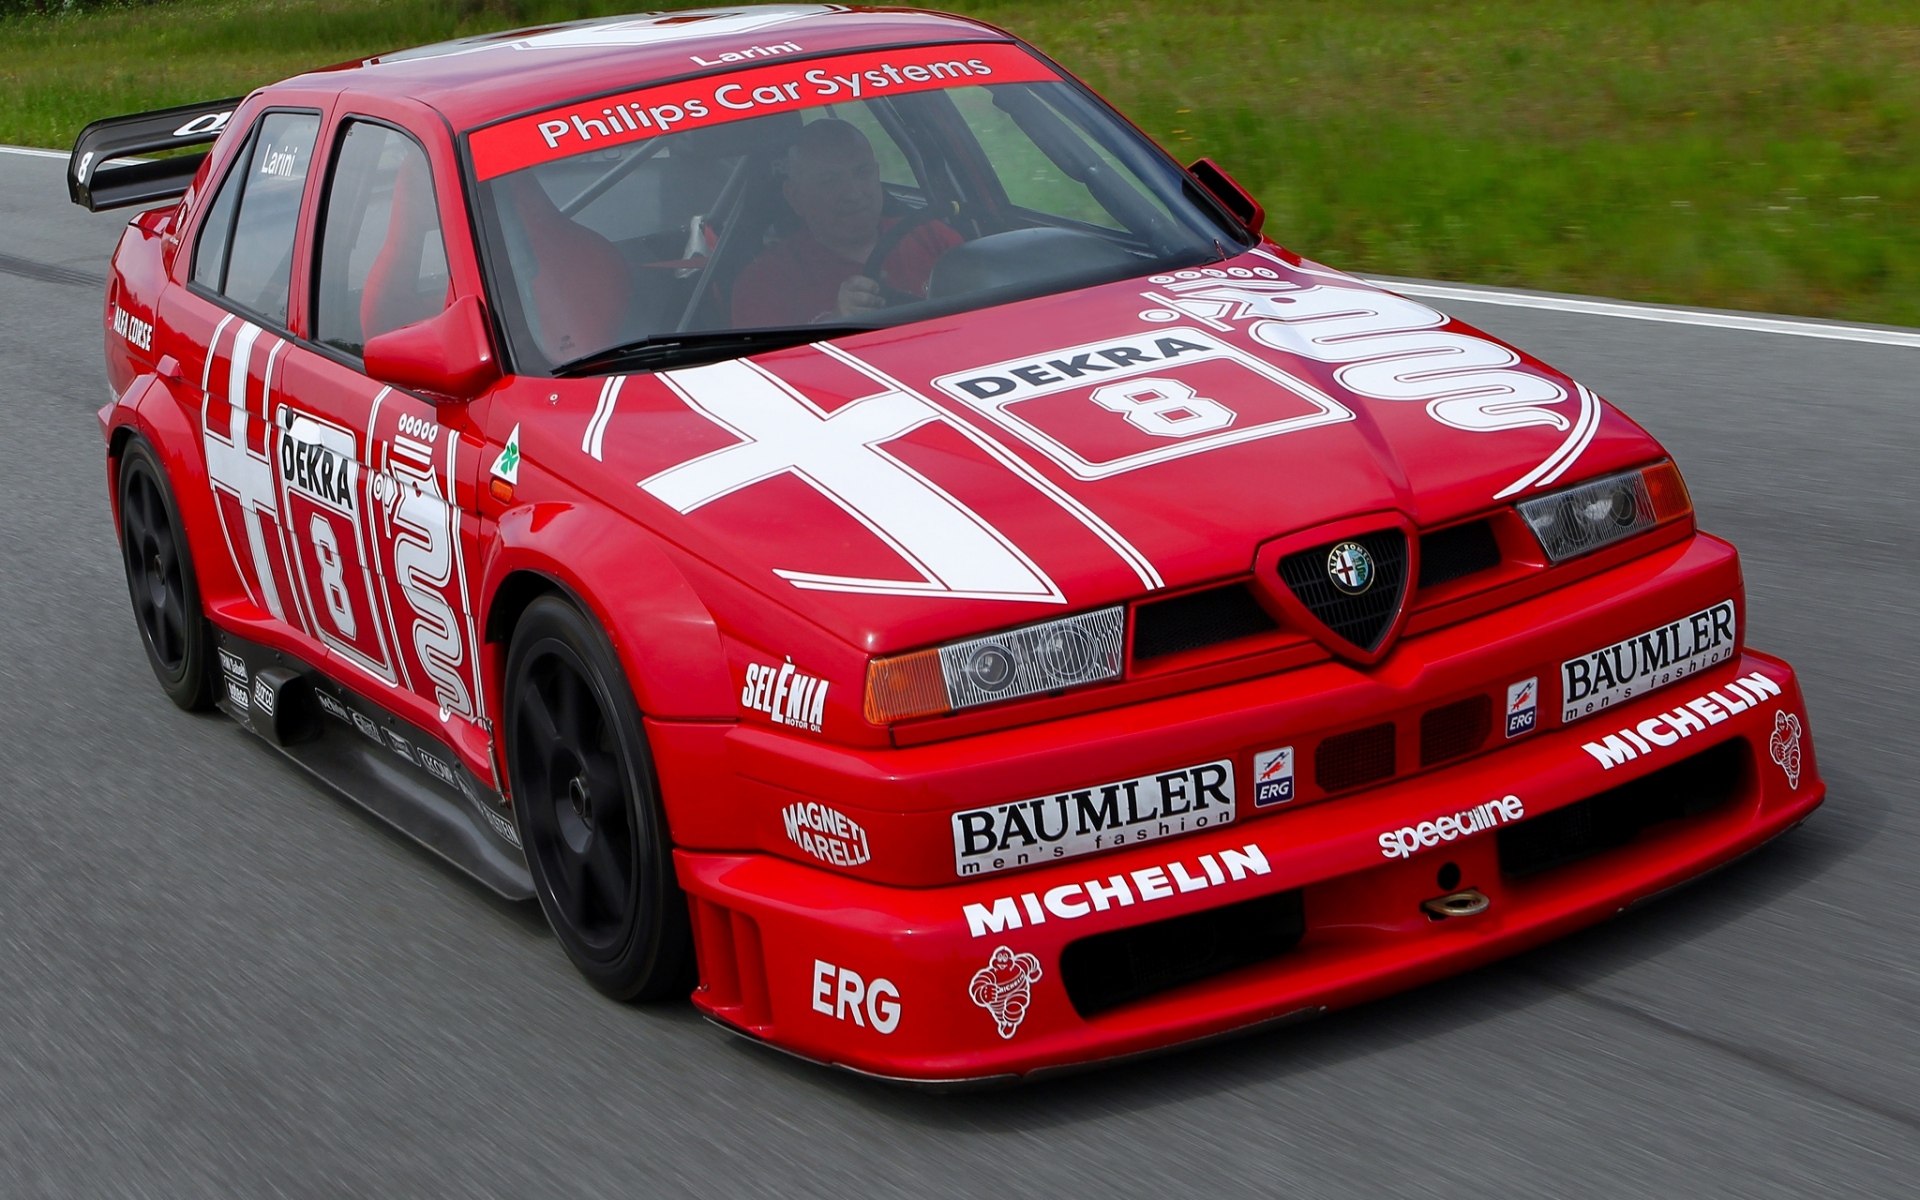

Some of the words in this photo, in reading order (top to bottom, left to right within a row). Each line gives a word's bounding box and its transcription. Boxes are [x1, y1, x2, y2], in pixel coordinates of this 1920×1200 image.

[690, 41, 803, 68] Larini
[538, 97, 708, 149] Philips
[714, 80, 801, 110] Car
[804, 56, 993, 97] Systems
[78, 151, 94, 184] 8
[261, 144, 298, 177] Larini
[113, 306, 129, 338] ALFA
[128, 316, 153, 352] CORSE
[952, 336, 1215, 400] DEKRA
[1089, 377, 1239, 439] 8
[282, 433, 353, 510] DEKRA
[310, 512, 356, 641] 8
[1330, 550, 1343, 574] ALFA
[1564, 605, 1733, 703] BÄUMLER
[1566, 686, 1632, 721] men's
[1650, 645, 1733, 689] fashion
[742, 655, 829, 726] SELÈNIA
[1509, 711, 1534, 731] ERG
[1581, 672, 1782, 770] MICHELIN
[785, 717, 808, 730] MOTOR
[810, 723, 822, 733] OIL
[957, 763, 1231, 857] BÄUMLER
[1259, 782, 1290, 800] ERG
[962, 844, 1064, 874] men's
[1095, 809, 1231, 847] fashion
[962, 844, 1272, 938] MICHELIN
[813, 959, 901, 1035] ERG
